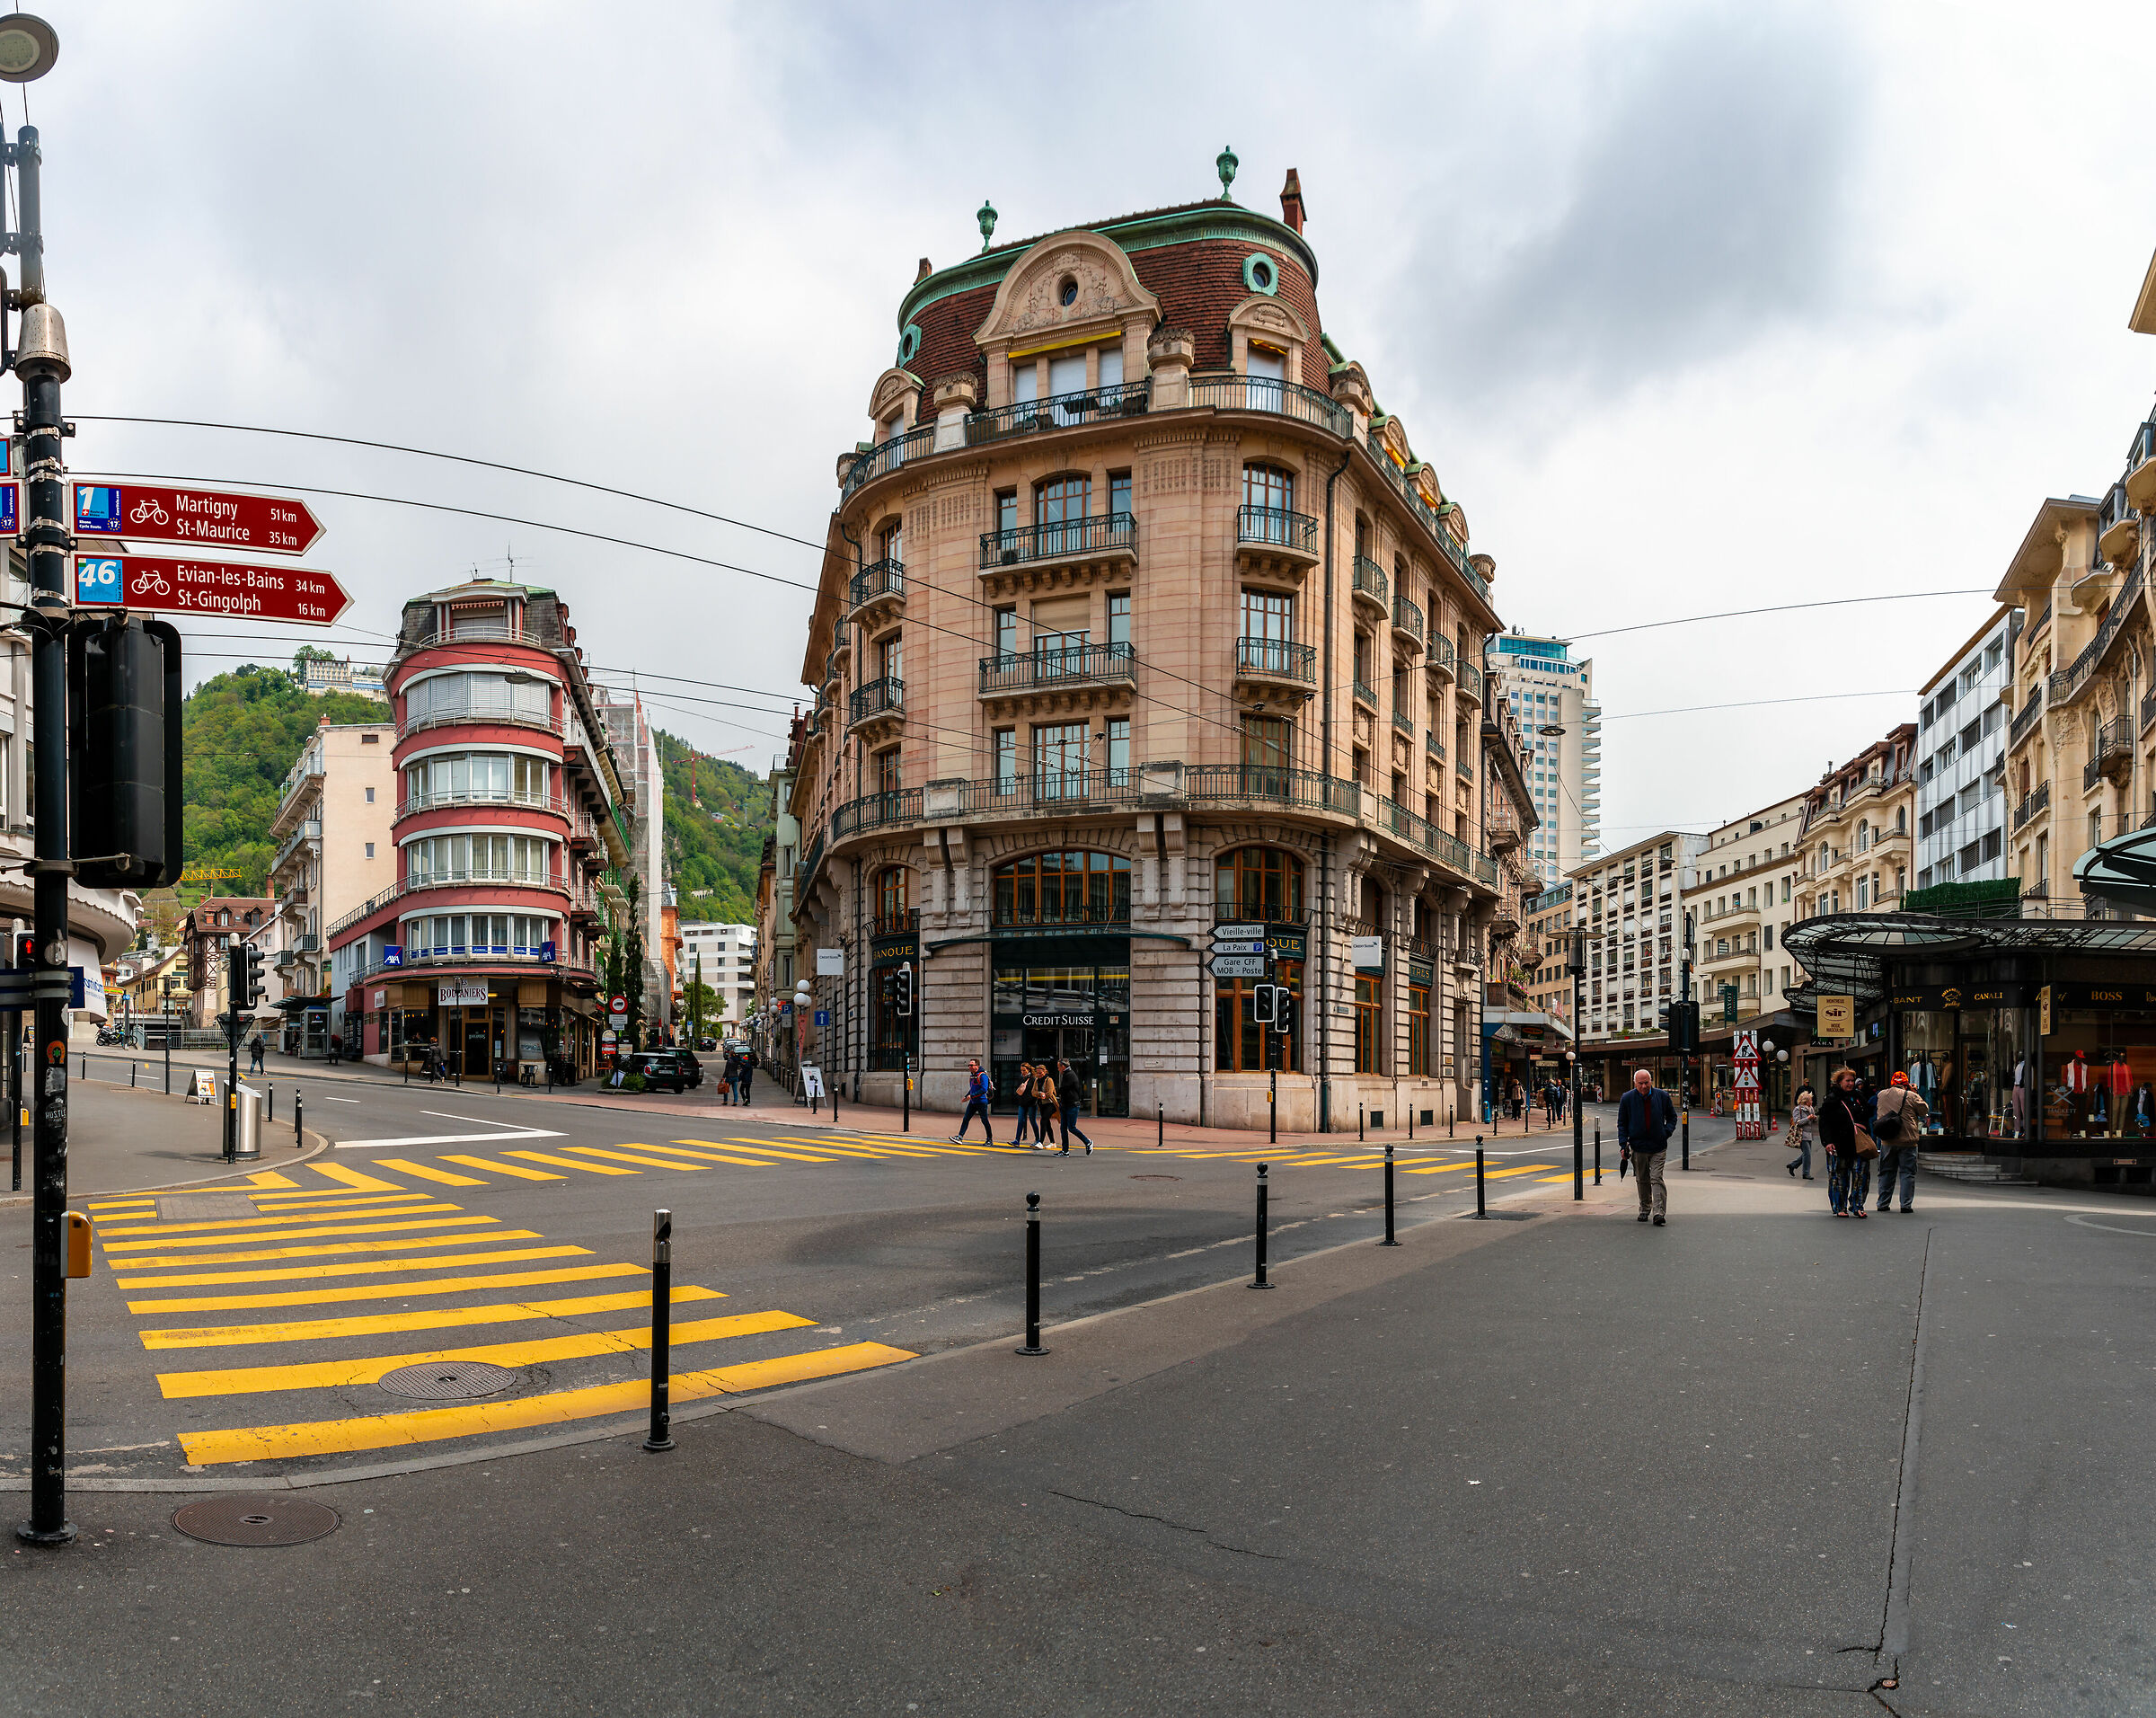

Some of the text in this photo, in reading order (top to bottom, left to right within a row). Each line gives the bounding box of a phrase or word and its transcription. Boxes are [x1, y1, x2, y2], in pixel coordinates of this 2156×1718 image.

[79, 487, 94, 509] 1
[176, 494, 238, 520] Martigny
[270, 508, 297, 523] 51 km
[110, 520, 119, 528] 17
[176, 518, 250, 541] St-Maurice
[269, 531, 297, 545] 35 km
[79, 561, 117, 587] 46
[177, 565, 284, 590] Evian-les-Bains
[296, 580, 325, 595] 34 km
[178, 589, 261, 615] St-Gingolph
[297, 602, 325, 617] 16 km
[1222, 927, 1262, 935] Vieille-ville
[384, 955, 400, 963] AXA
[542, 952, 552, 961] AXA
[1224, 958, 1256, 966] Gare CFF
[440, 987, 486, 1002] BOUANIERS
[1974, 992, 2003, 1000] CANALI
[2091, 991, 2123, 1001] BOSS
[1022, 1014, 1094, 1025] CREDIT SUISSE
[1825, 1008, 1846, 1017] sir
